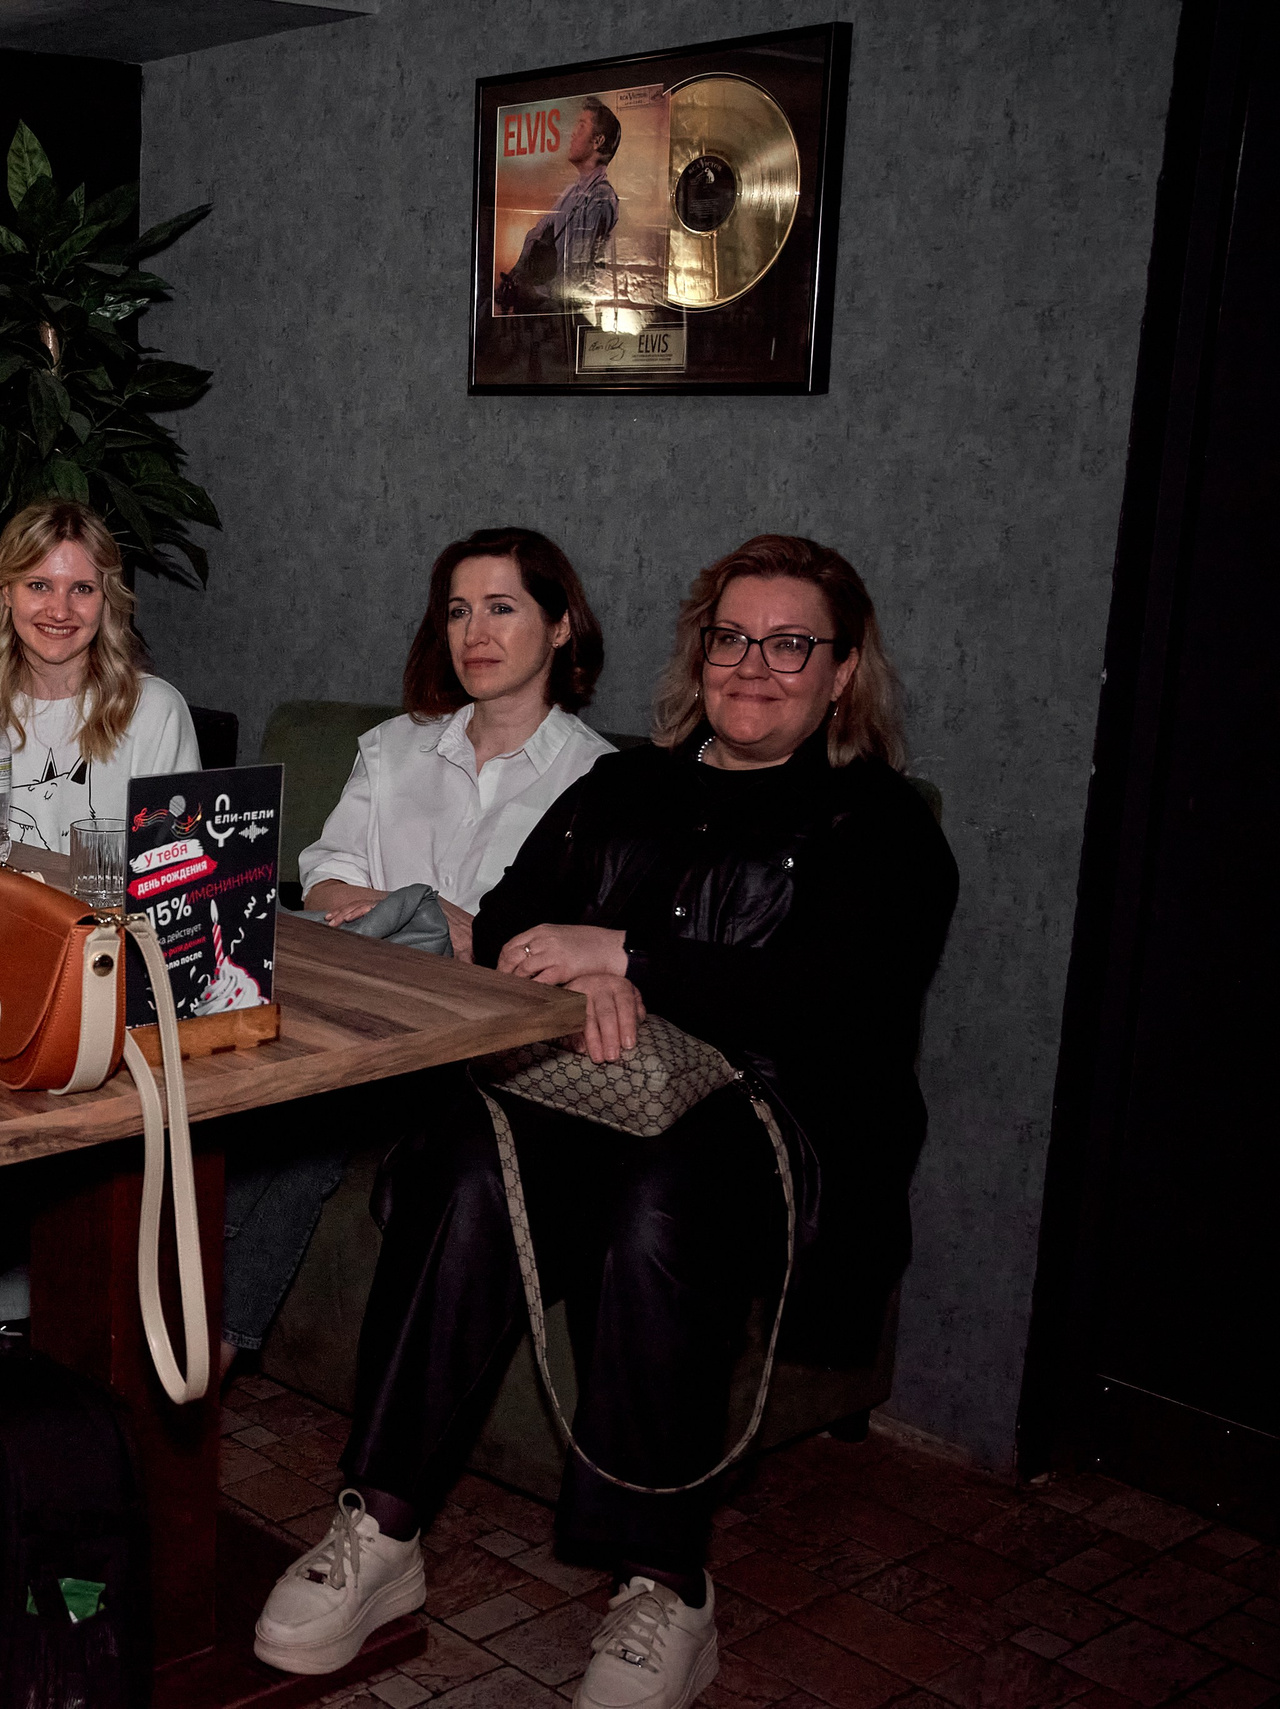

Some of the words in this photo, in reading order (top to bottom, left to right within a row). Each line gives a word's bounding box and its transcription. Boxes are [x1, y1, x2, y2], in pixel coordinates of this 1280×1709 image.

[503, 108, 560, 157] ELVIS
[638, 334, 669, 353] ELVIS
[214, 809, 274, 824] ЕЛИ-ПЕЛИ
[156, 843, 188, 863] тебя
[137, 878, 160, 896] ДЕНЬ
[161, 860, 207, 884] РОЖДЕНИЯ
[186, 862, 275, 905] имениннику
[167, 923, 202, 944] действует
[181, 950, 203, 965] после
